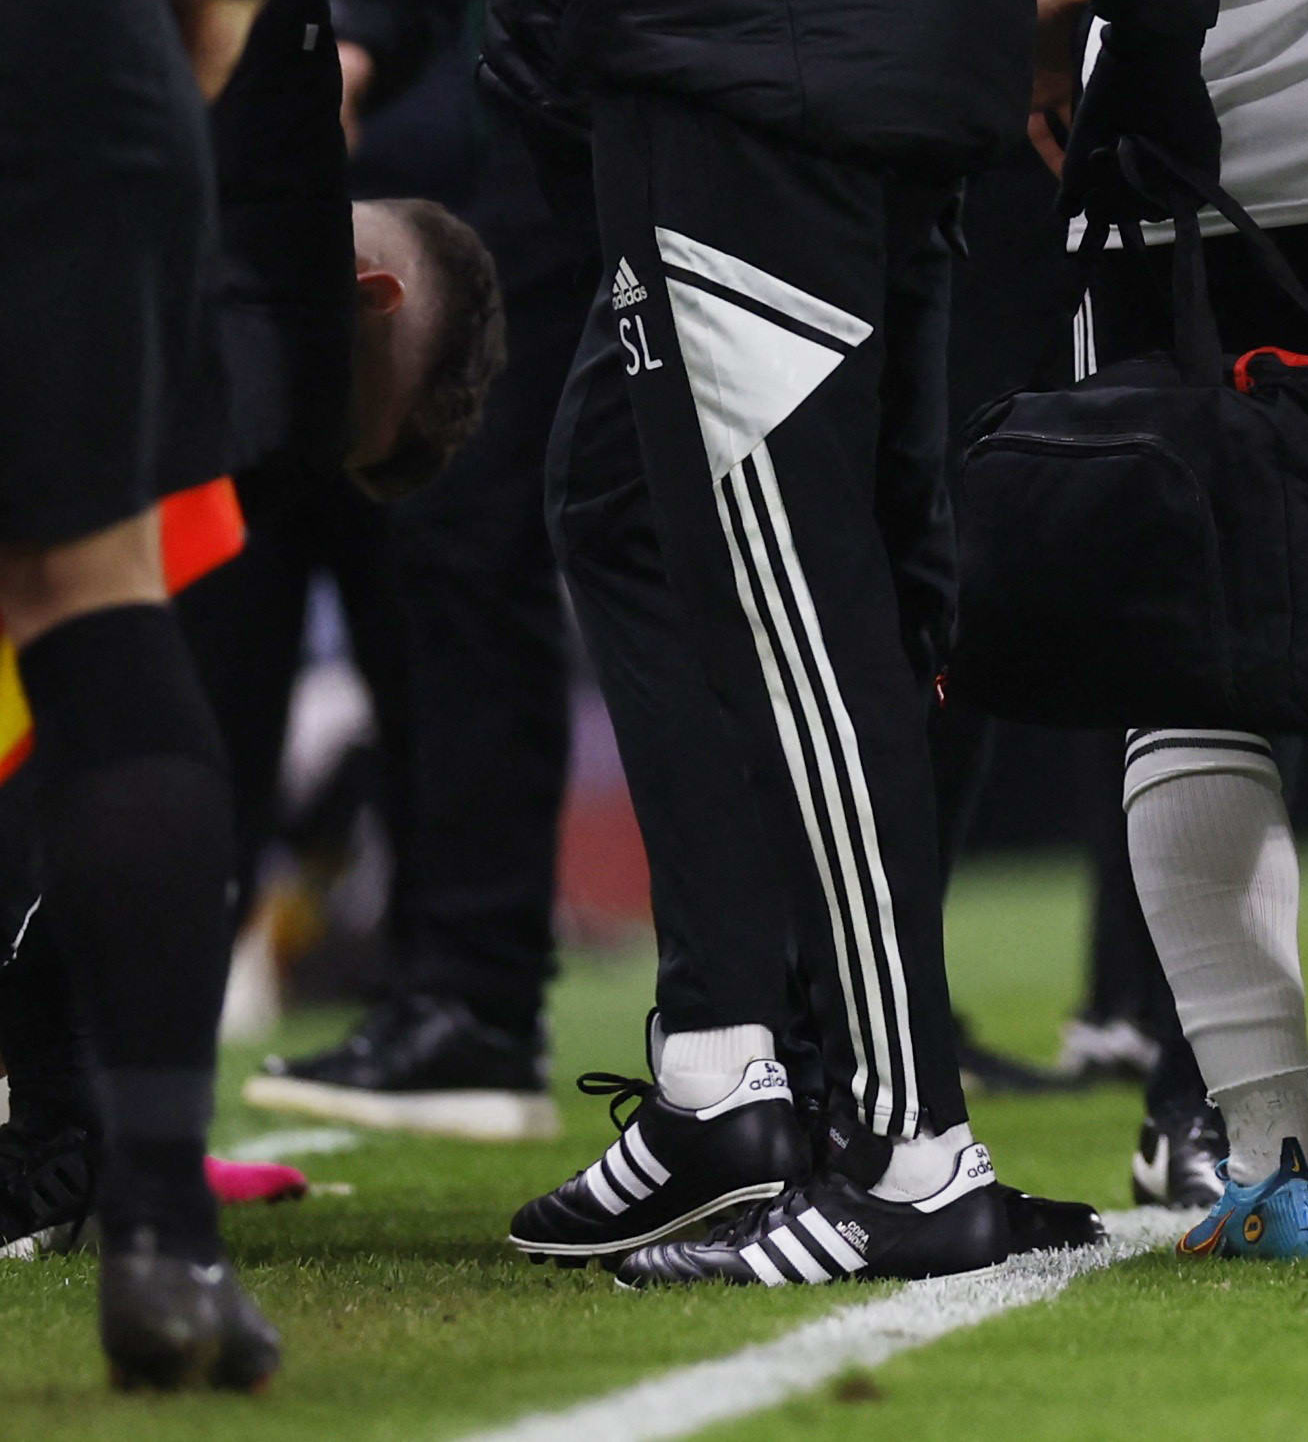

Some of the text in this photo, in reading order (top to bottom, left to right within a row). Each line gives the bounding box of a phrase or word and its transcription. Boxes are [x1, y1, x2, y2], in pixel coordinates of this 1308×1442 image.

[612, 285, 648, 311] adidas
[618, 314, 663, 376] SL
[835, 1221, 869, 1256] MUNDIAL
[847, 1220, 870, 1245] COPA
